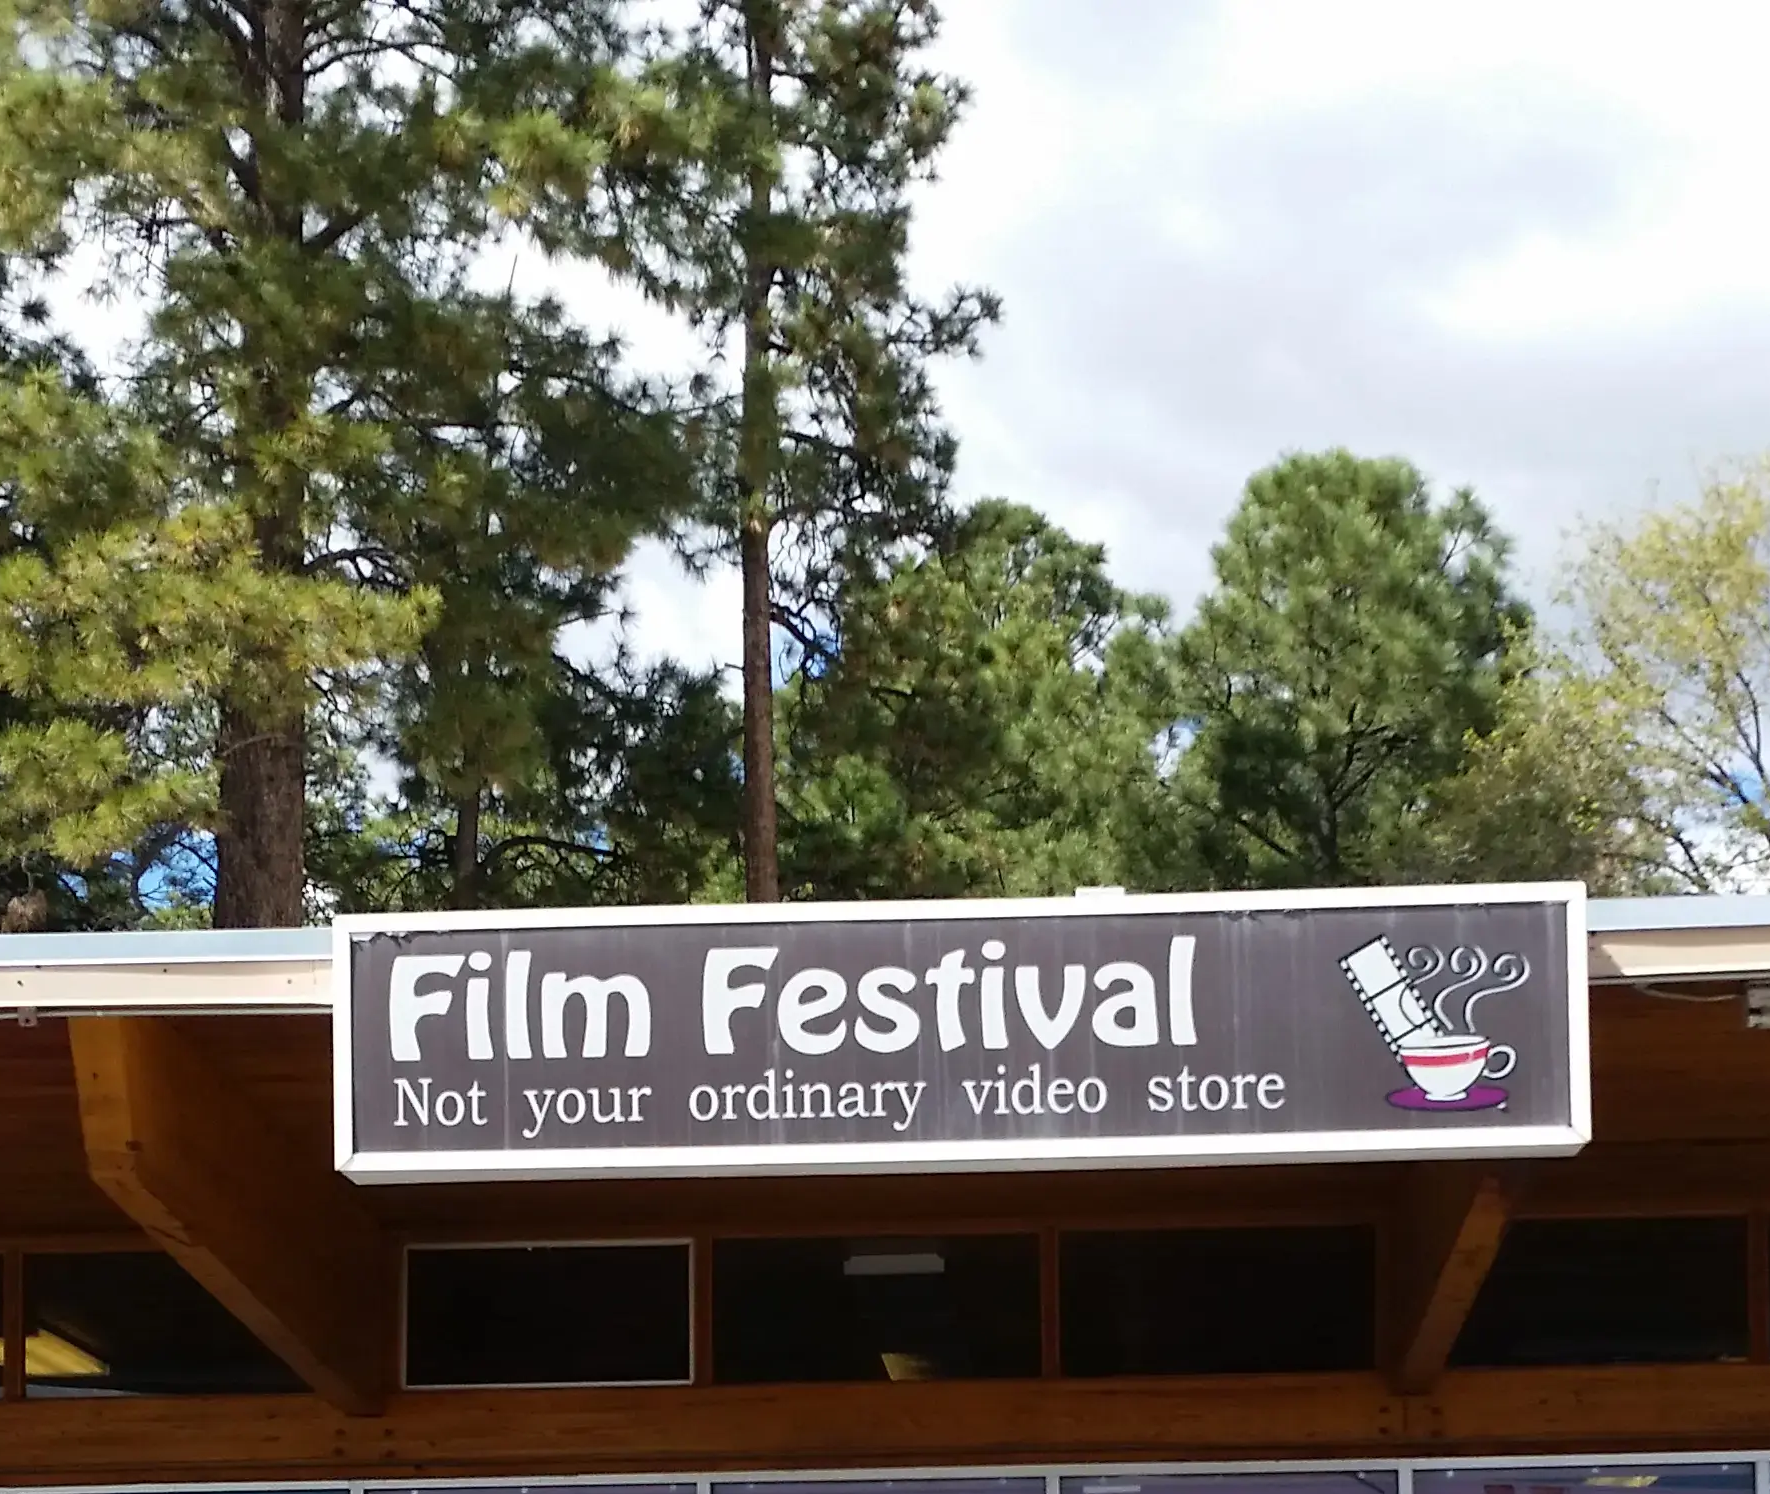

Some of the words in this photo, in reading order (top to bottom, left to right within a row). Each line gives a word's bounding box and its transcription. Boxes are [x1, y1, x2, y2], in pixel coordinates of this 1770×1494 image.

[389, 950, 651, 1061] Film
[702, 935, 1198, 1056] Festival
[393, 1077, 488, 1127] Not
[521, 1084, 653, 1140] your
[688, 1067, 927, 1132] ordinary
[961, 1063, 1109, 1116] video
[1146, 1065, 1287, 1114] store
